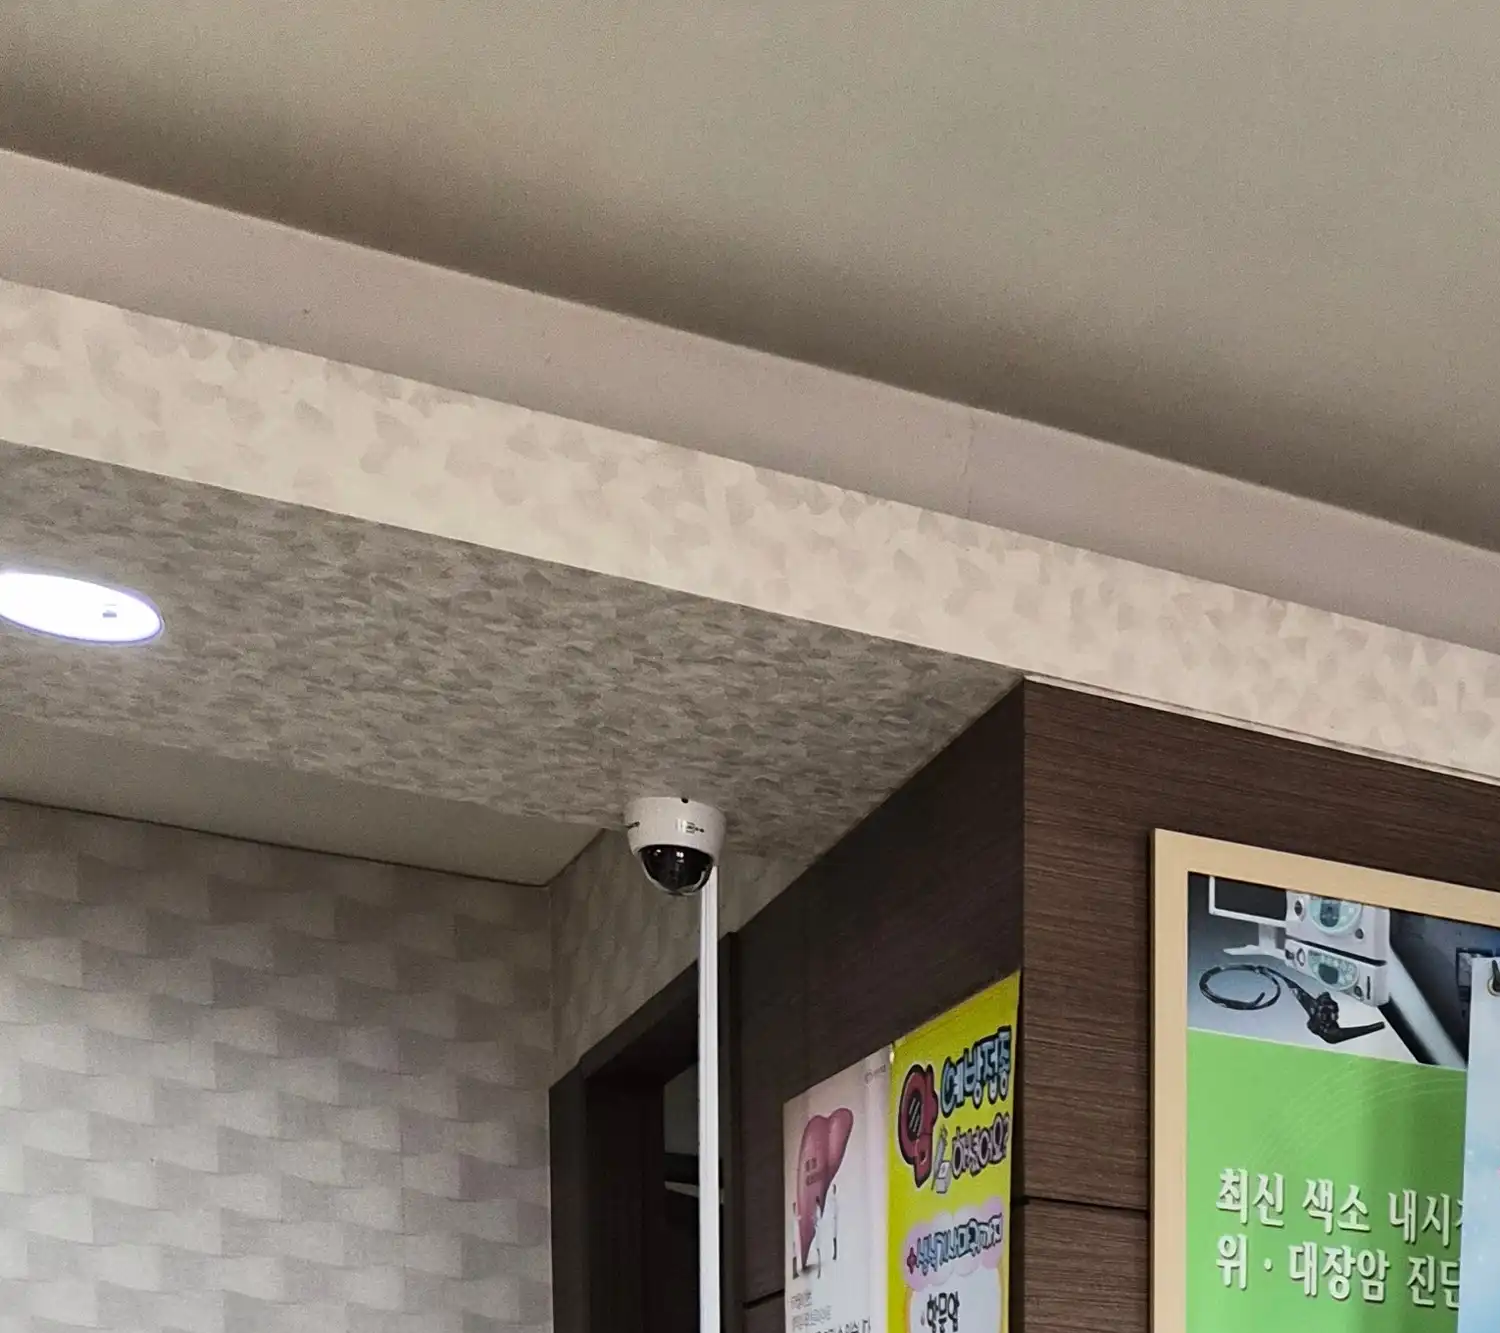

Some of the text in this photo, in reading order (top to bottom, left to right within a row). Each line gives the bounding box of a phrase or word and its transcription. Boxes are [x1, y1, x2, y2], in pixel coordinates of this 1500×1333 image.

[1215, 1167, 1286, 1228] 최신
[1303, 1178, 1372, 1235] 색소
[1215, 1233, 1392, 1304] 위 대장암
